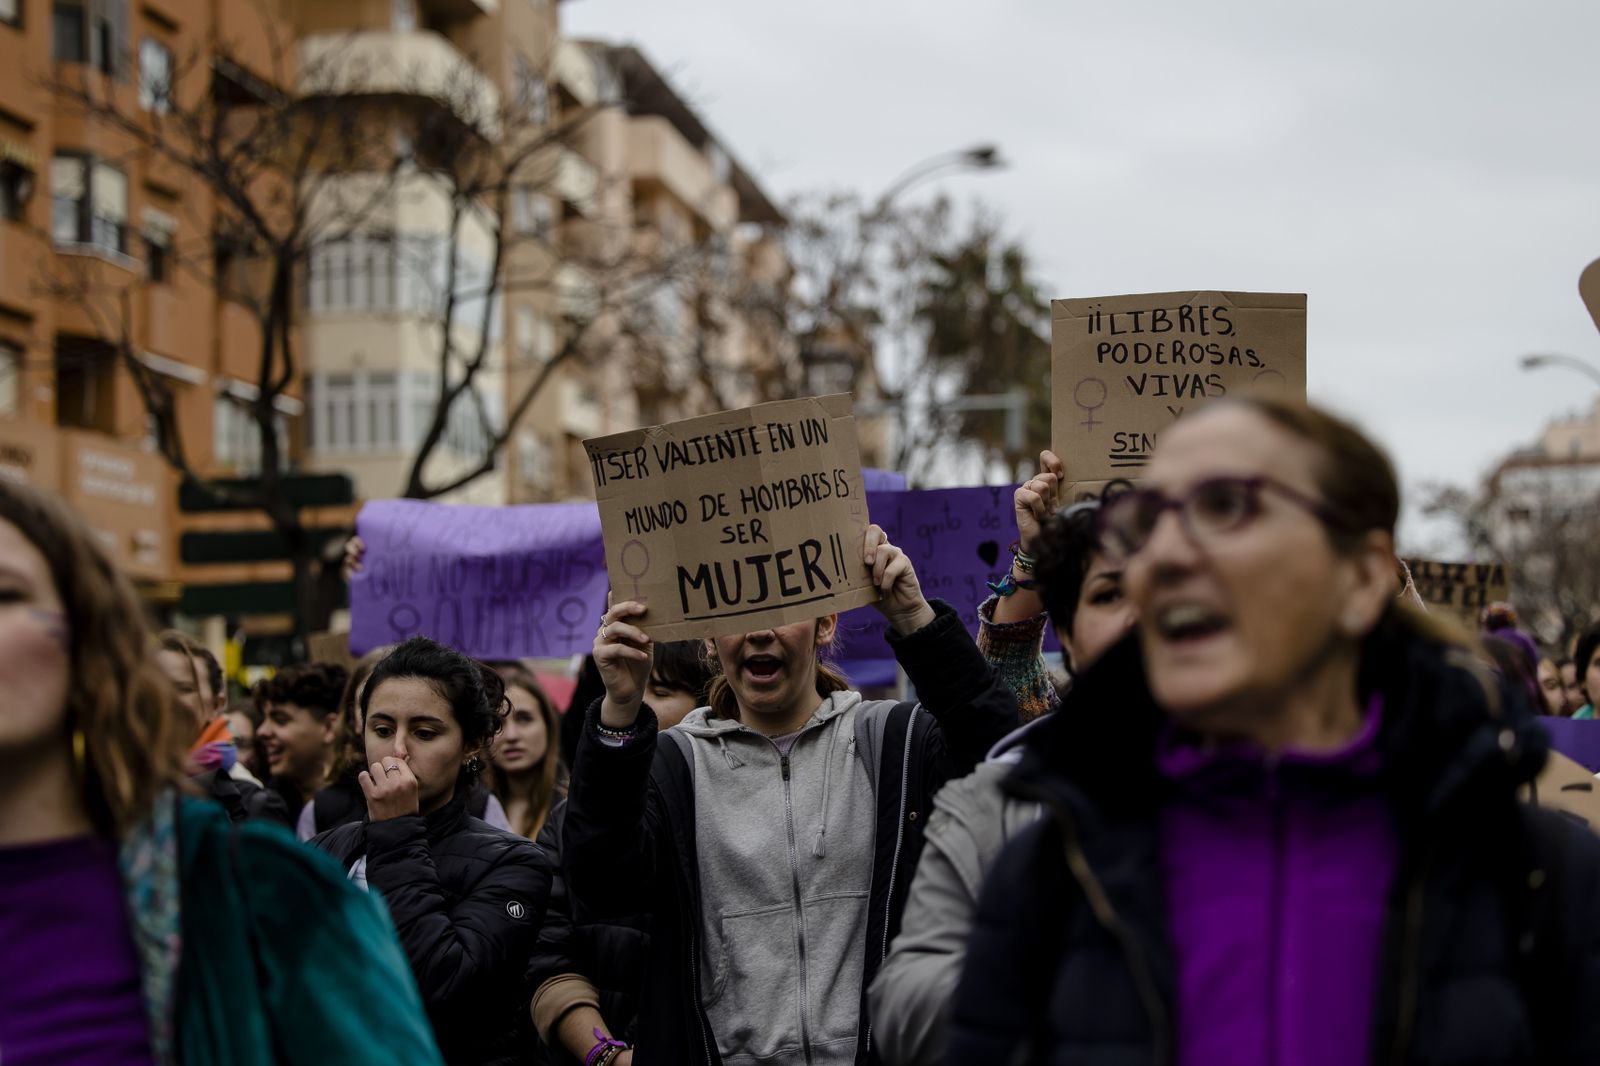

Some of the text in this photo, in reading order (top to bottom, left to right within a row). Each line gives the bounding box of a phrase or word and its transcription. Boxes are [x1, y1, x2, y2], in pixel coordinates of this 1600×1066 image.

[1097, 340, 1265, 369] PODEROSAS,
[1126, 373, 1226, 399] VIVAS
[652, 425, 762, 474] VALIENTE
[767, 422, 796, 453] EN
[800, 418, 829, 447] UN
[1110, 432, 1157, 453] SIN
[625, 499, 688, 535] MUNDO
[699, 493, 730, 522] DE
[740, 471, 832, 514] HOMBRES
[833, 469, 849, 498] ES
[720, 518, 768, 544] SER
[677, 532, 850, 614] MUJER!!
